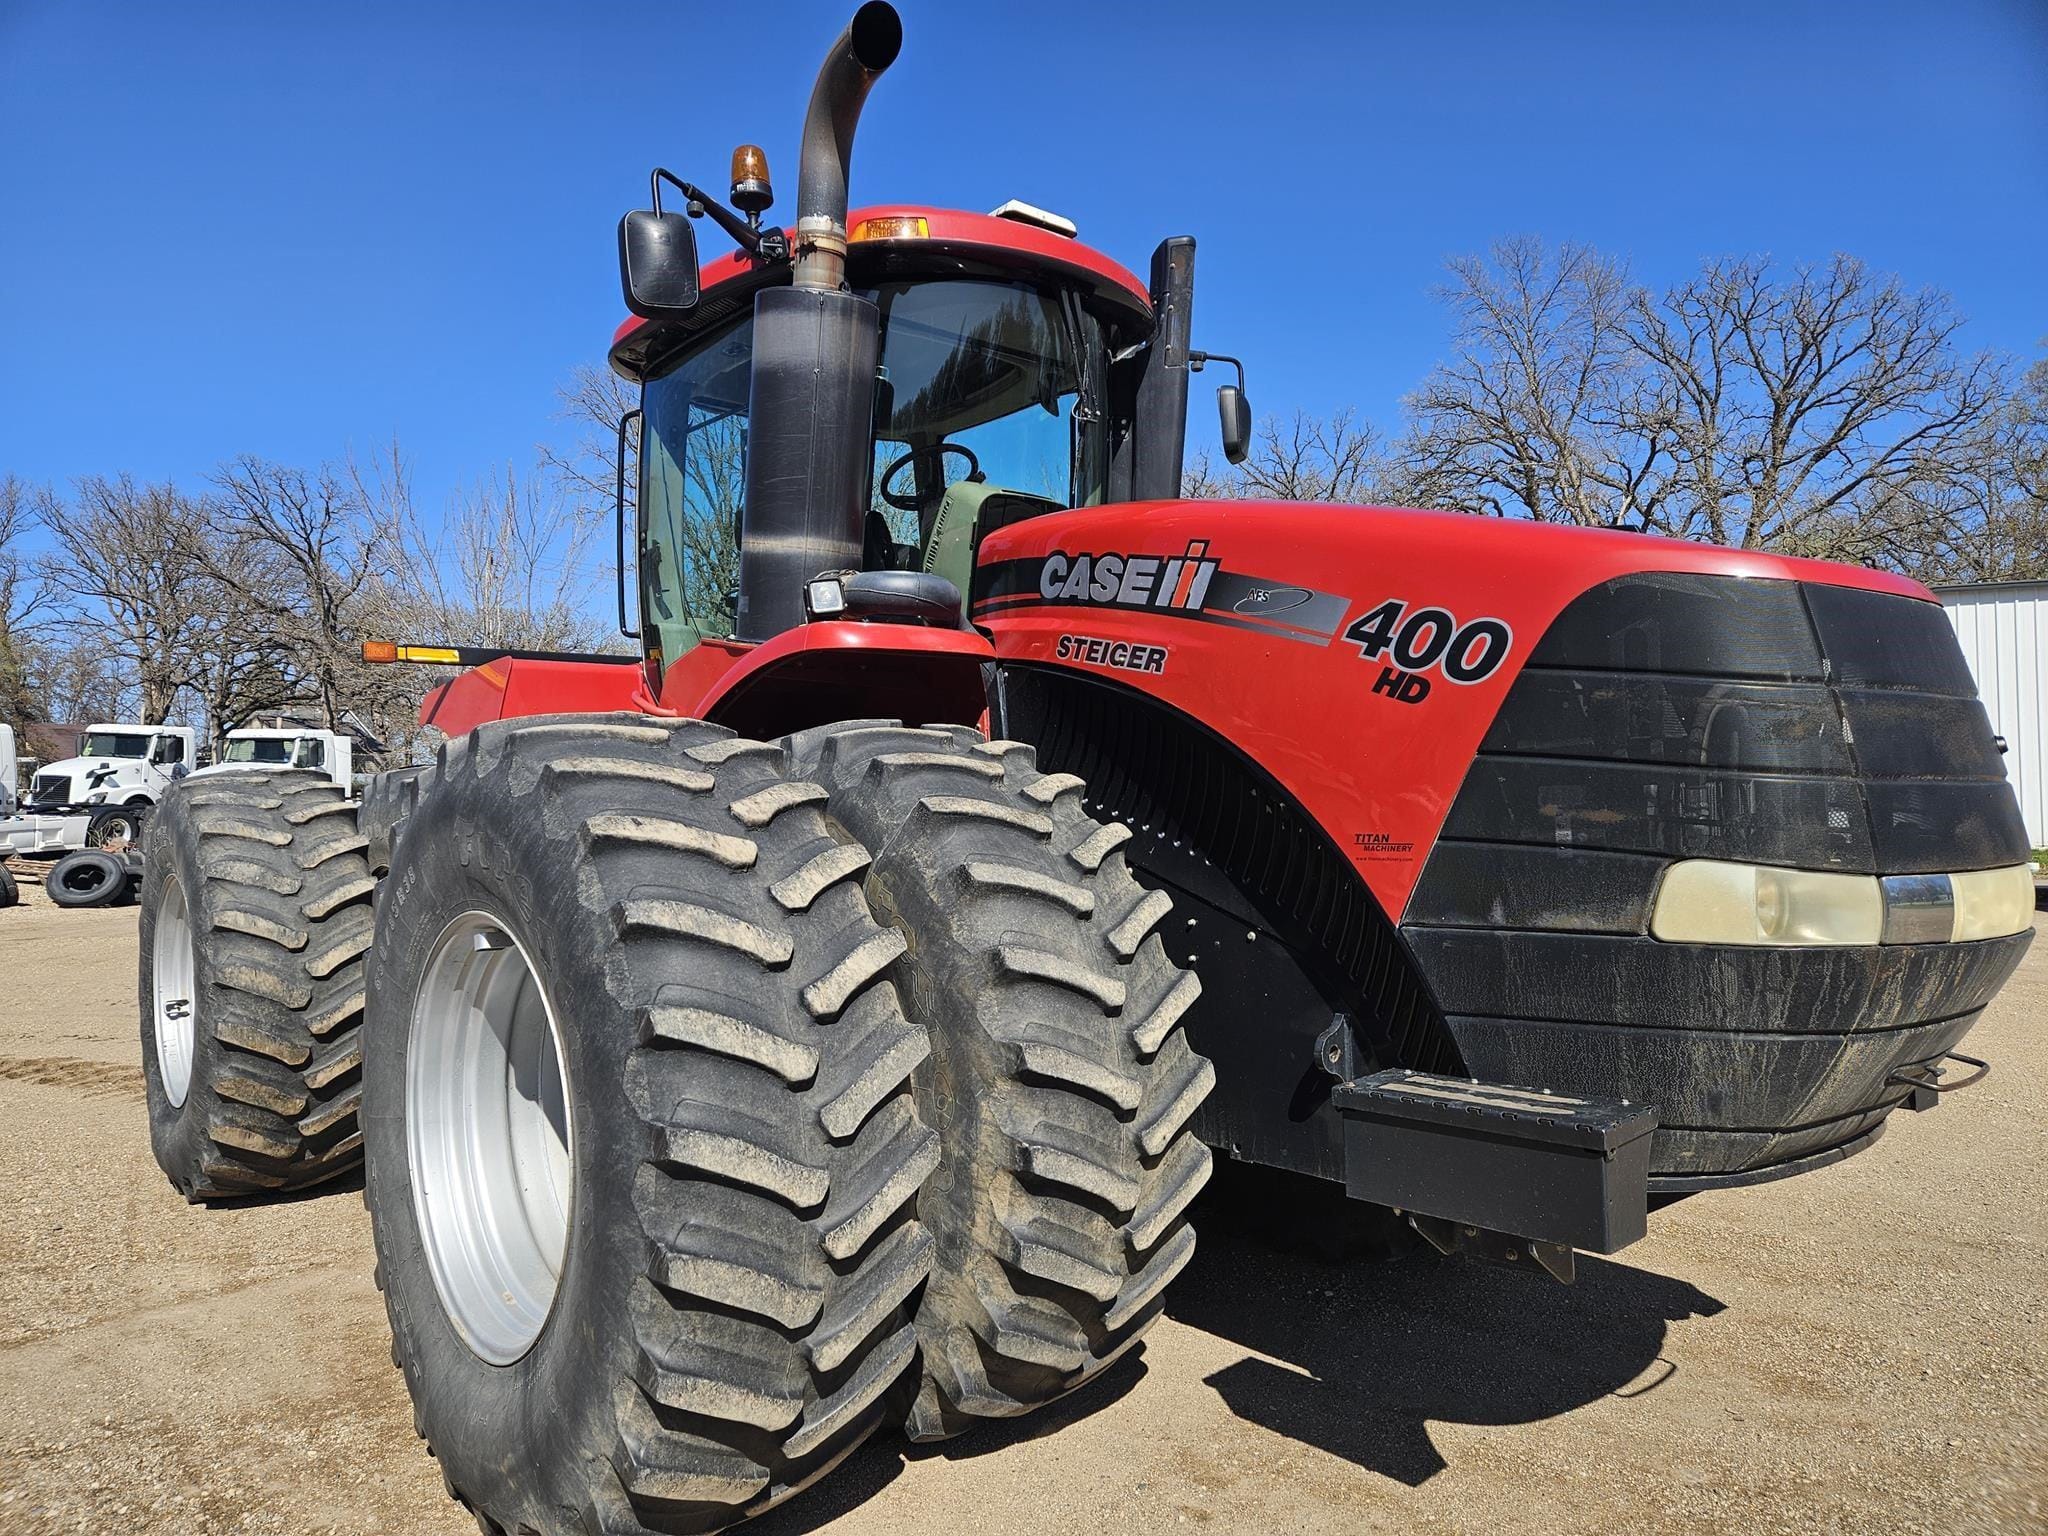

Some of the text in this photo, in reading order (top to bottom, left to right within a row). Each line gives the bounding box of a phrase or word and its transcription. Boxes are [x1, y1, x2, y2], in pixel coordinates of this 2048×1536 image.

[1039, 553, 1161, 606] CASE
[1247, 588, 1270, 603] AFS
[1056, 633, 1168, 675] STEIGER
[1341, 598, 1514, 686] 400
[1371, 666, 1431, 705] HD
[1354, 833, 1391, 843] TITAN
[1363, 844, 1414, 853] MACHINERY
